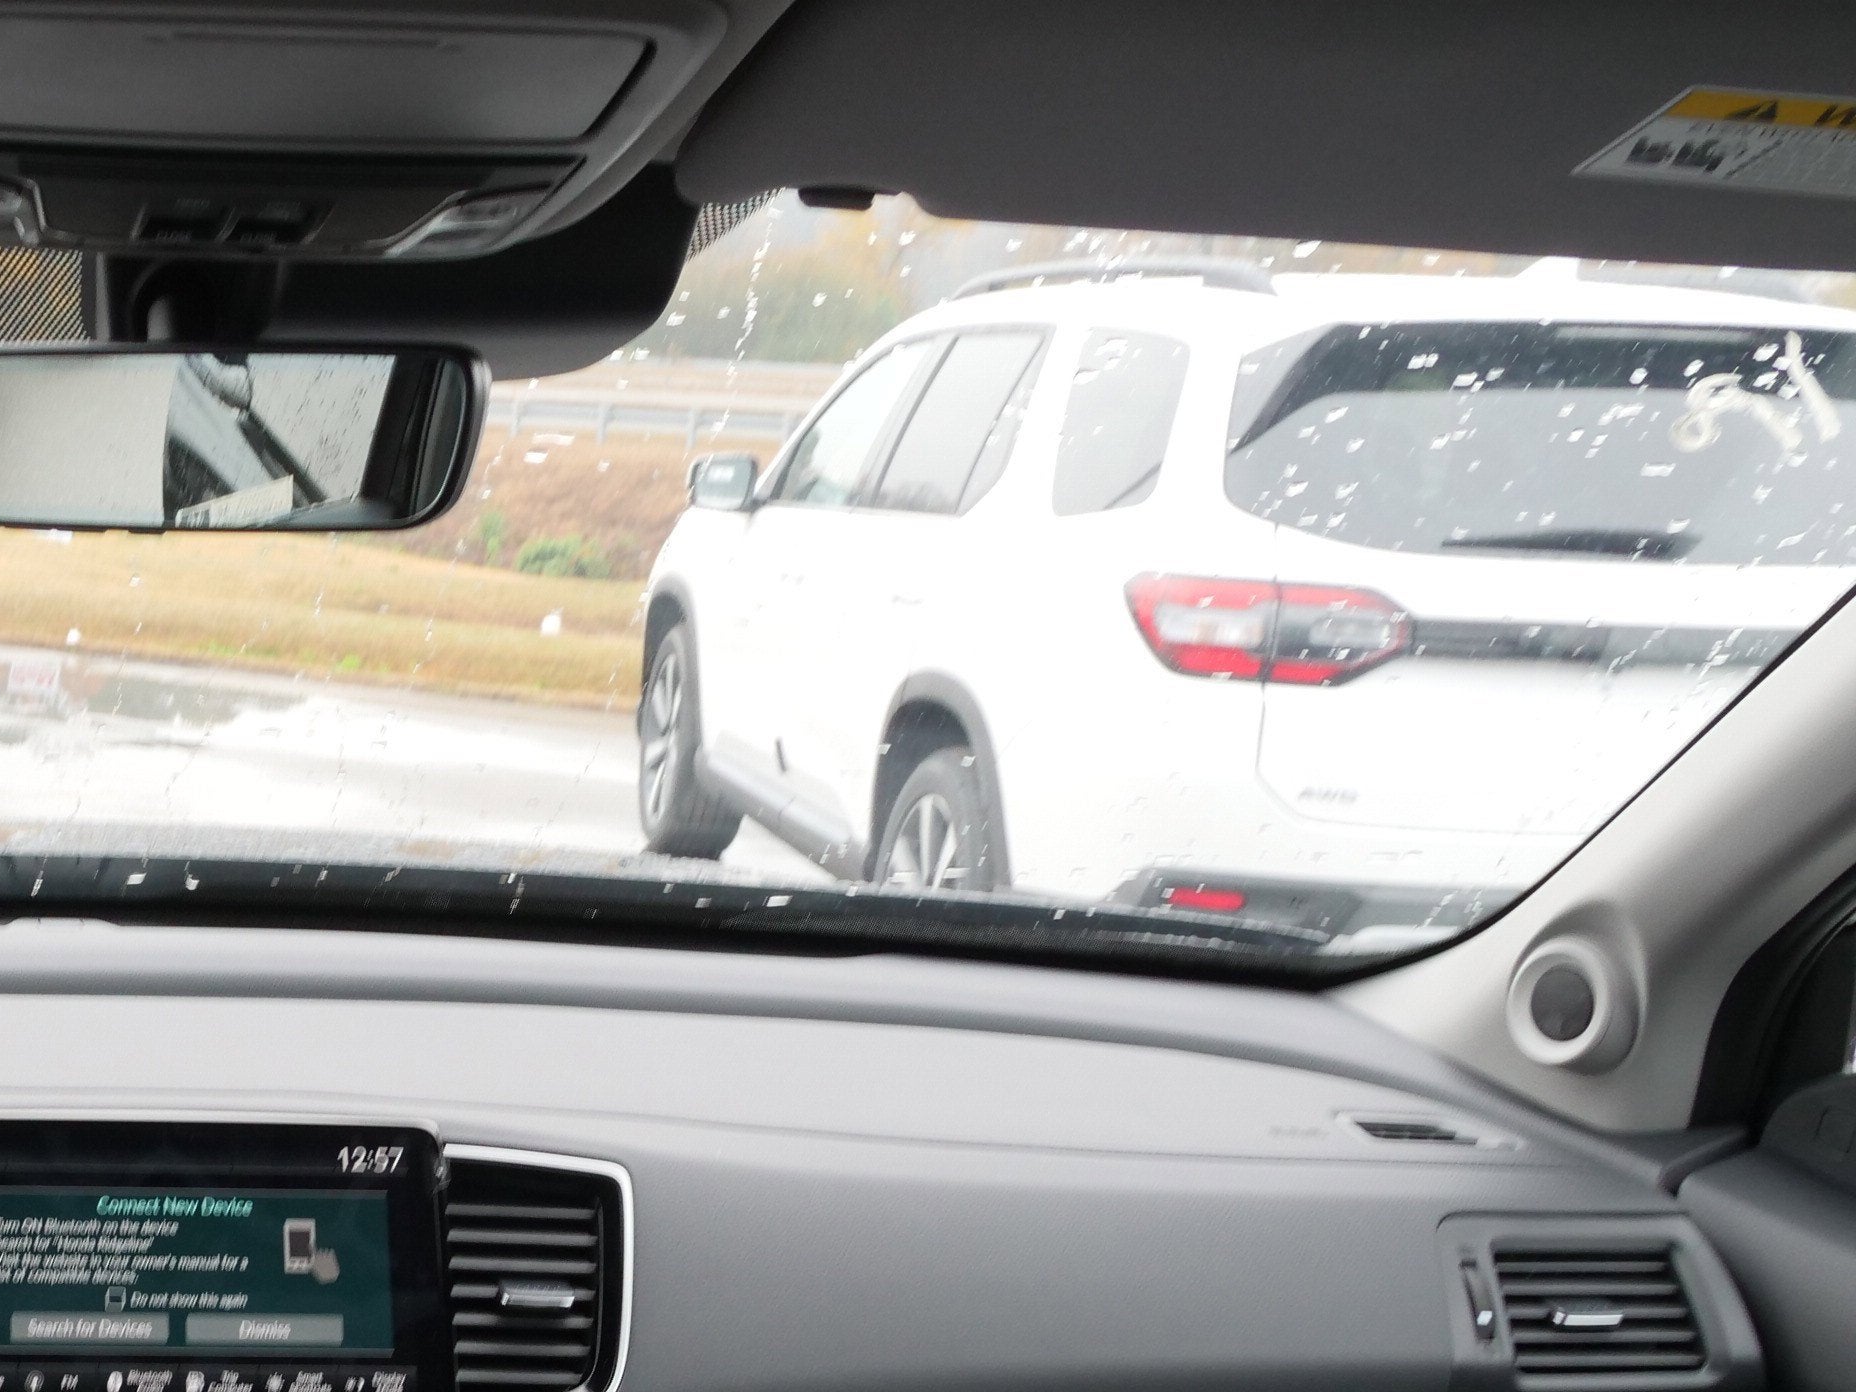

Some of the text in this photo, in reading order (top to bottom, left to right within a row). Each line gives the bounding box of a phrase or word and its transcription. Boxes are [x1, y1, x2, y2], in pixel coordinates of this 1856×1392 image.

[337, 1146, 404, 1173] 12:57
[97, 1195, 254, 1217] Connect New Device
[44, 1217, 101, 1236] Bluetooth
[102, 1219, 119, 1236] on
[119, 1218, 141, 1237] the
[141, 1218, 179, 1238] device
[33, 1235, 52, 1252] for
[130, 1290, 249, 1311] Do not show this again
[27, 1318, 153, 1339] Search for Devices
[238, 1319, 291, 1341] Dismiss
